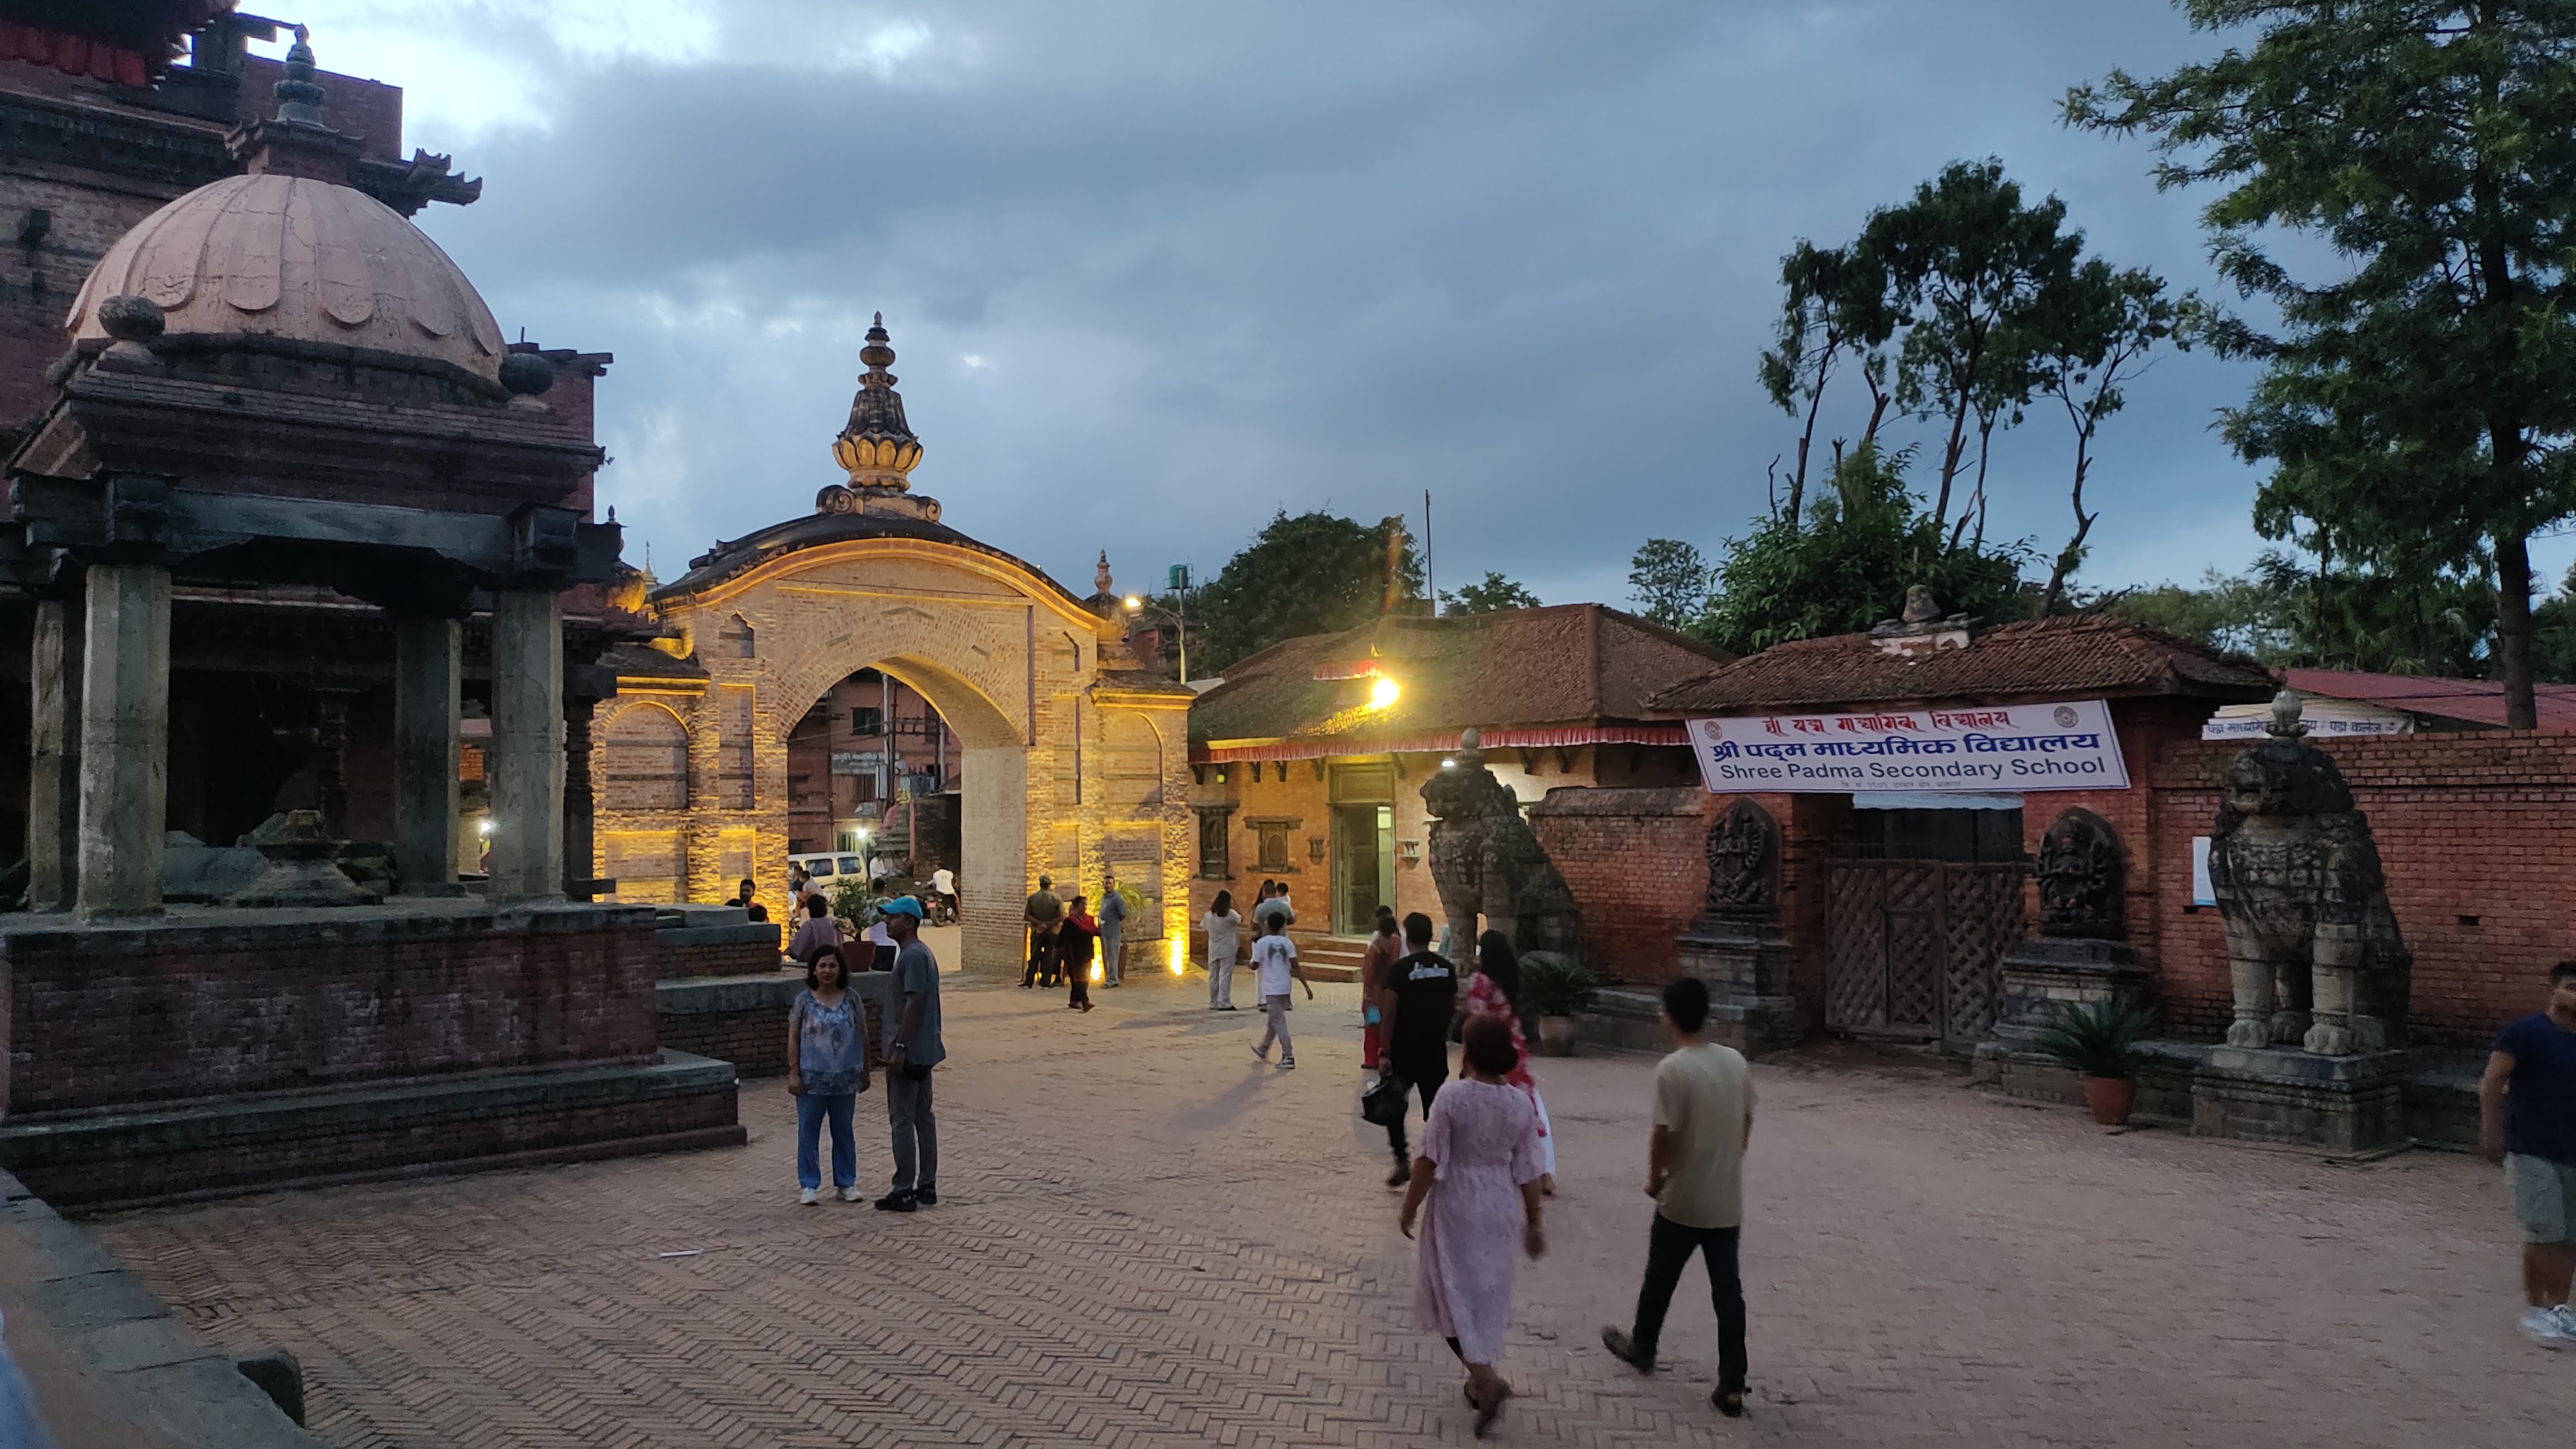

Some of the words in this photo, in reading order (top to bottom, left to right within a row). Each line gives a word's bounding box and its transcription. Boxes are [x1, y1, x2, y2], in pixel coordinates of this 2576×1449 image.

[1711, 741, 1740, 762] श्री
[1744, 743, 1807, 761] पद्म
[1811, 736, 1957, 756] माध्यमिक
[1963, 733, 2100, 753] विद्यालय
[1721, 765, 1782, 779] Shree
[1788, 763, 1864, 779] Padma
[1869, 761, 2003, 780] Secondary
[2011, 756, 2106, 775] School
